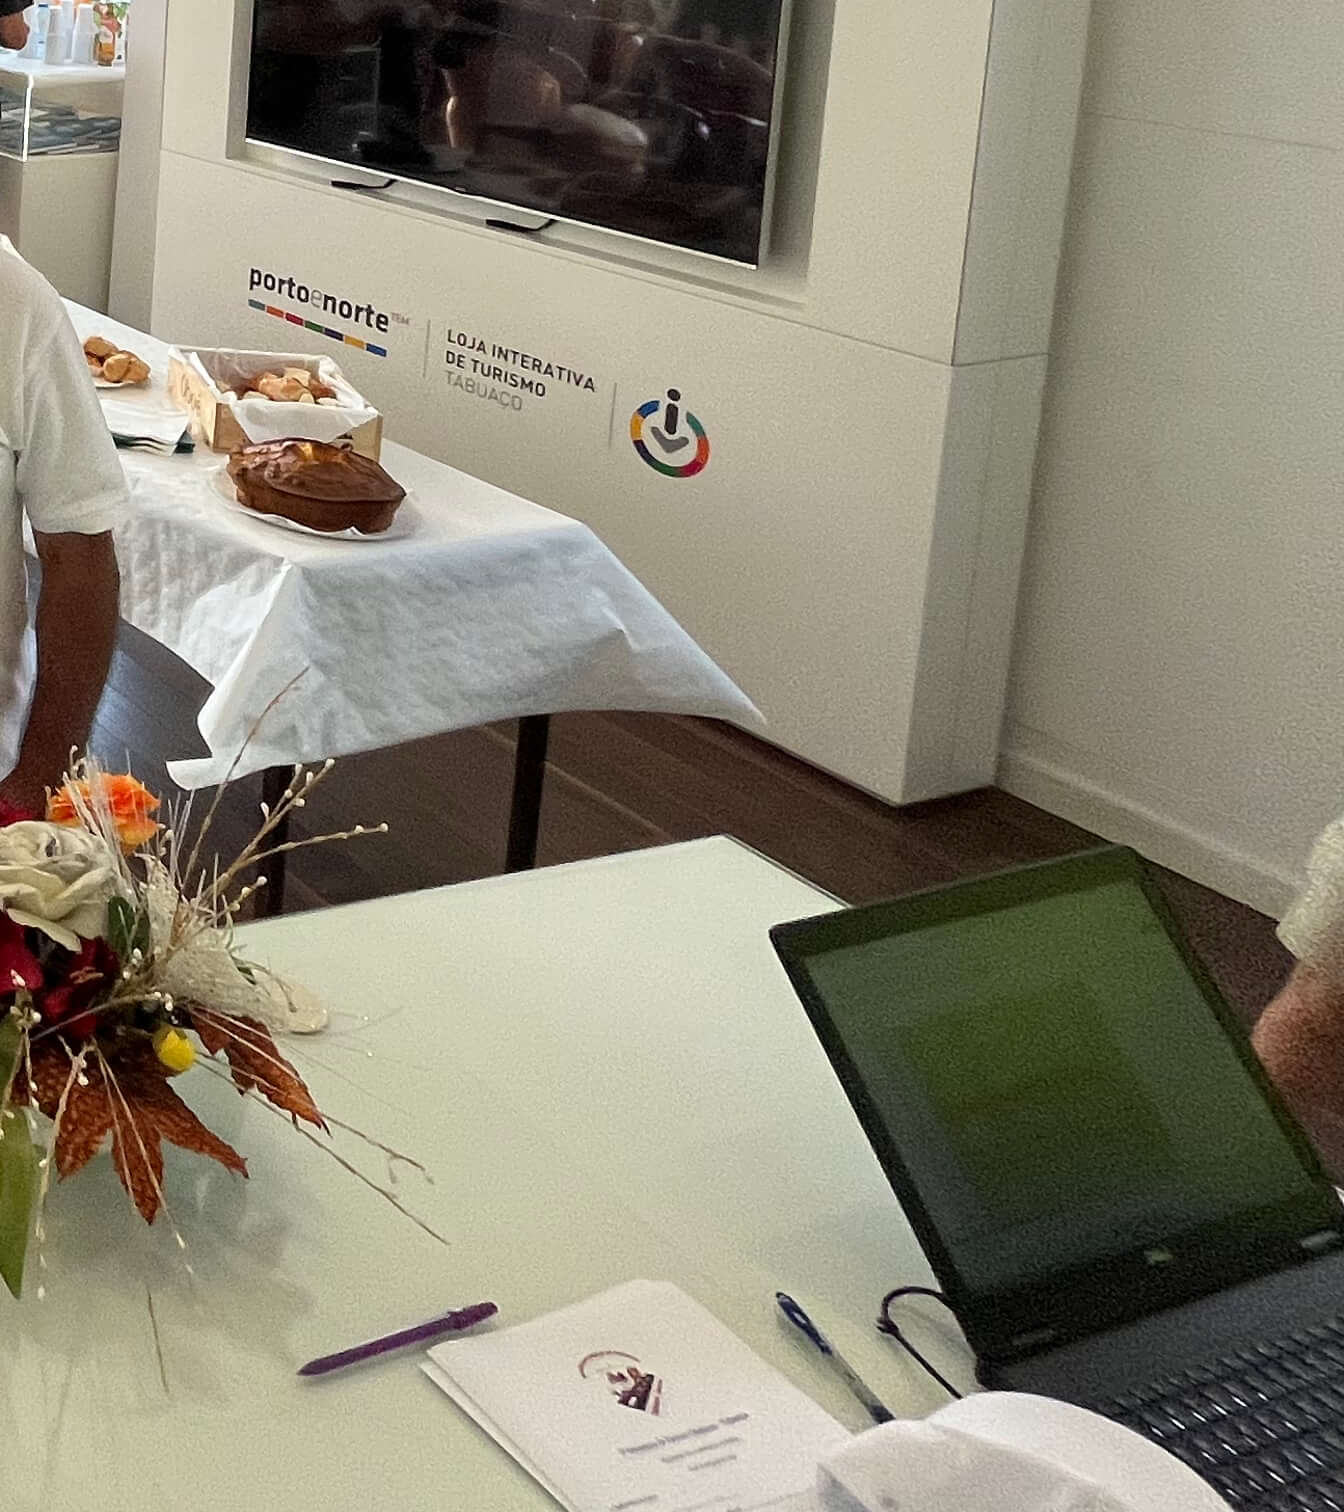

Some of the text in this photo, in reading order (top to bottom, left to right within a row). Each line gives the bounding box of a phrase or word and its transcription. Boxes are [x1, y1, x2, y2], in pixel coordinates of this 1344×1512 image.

[446, 351, 545, 397] DE TURISMO
[448, 329, 595, 392] LOJA INTERATIVA
[446, 370, 522, 411] TABUAÇO
